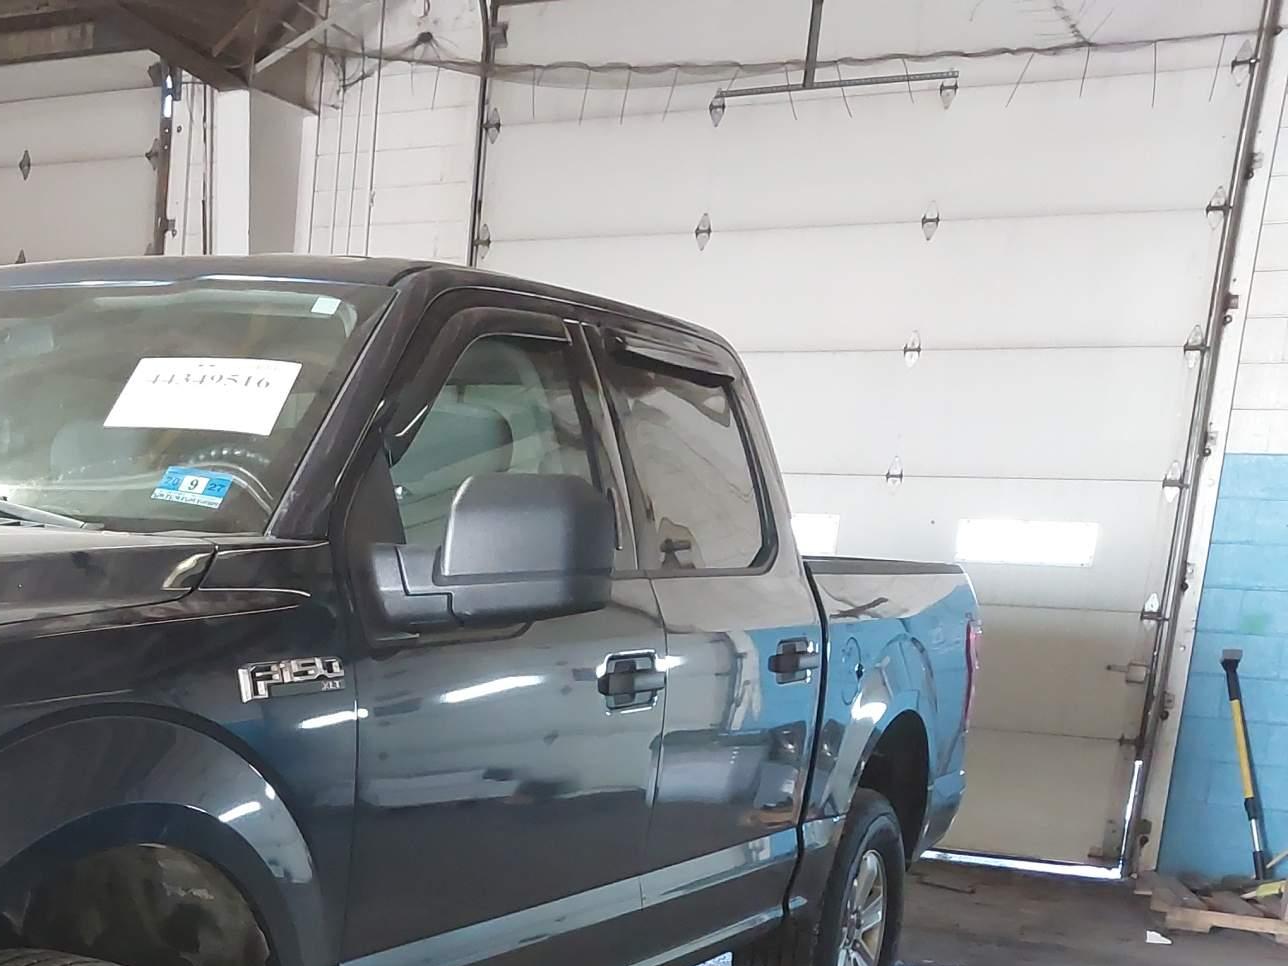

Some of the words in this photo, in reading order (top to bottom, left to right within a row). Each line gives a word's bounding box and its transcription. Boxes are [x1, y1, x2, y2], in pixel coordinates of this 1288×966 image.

[145, 373, 271, 390] 44349516
[187, 478, 200, 491] 9
[207, 482, 226, 493] 27
[321, 680, 343, 691] XLT
